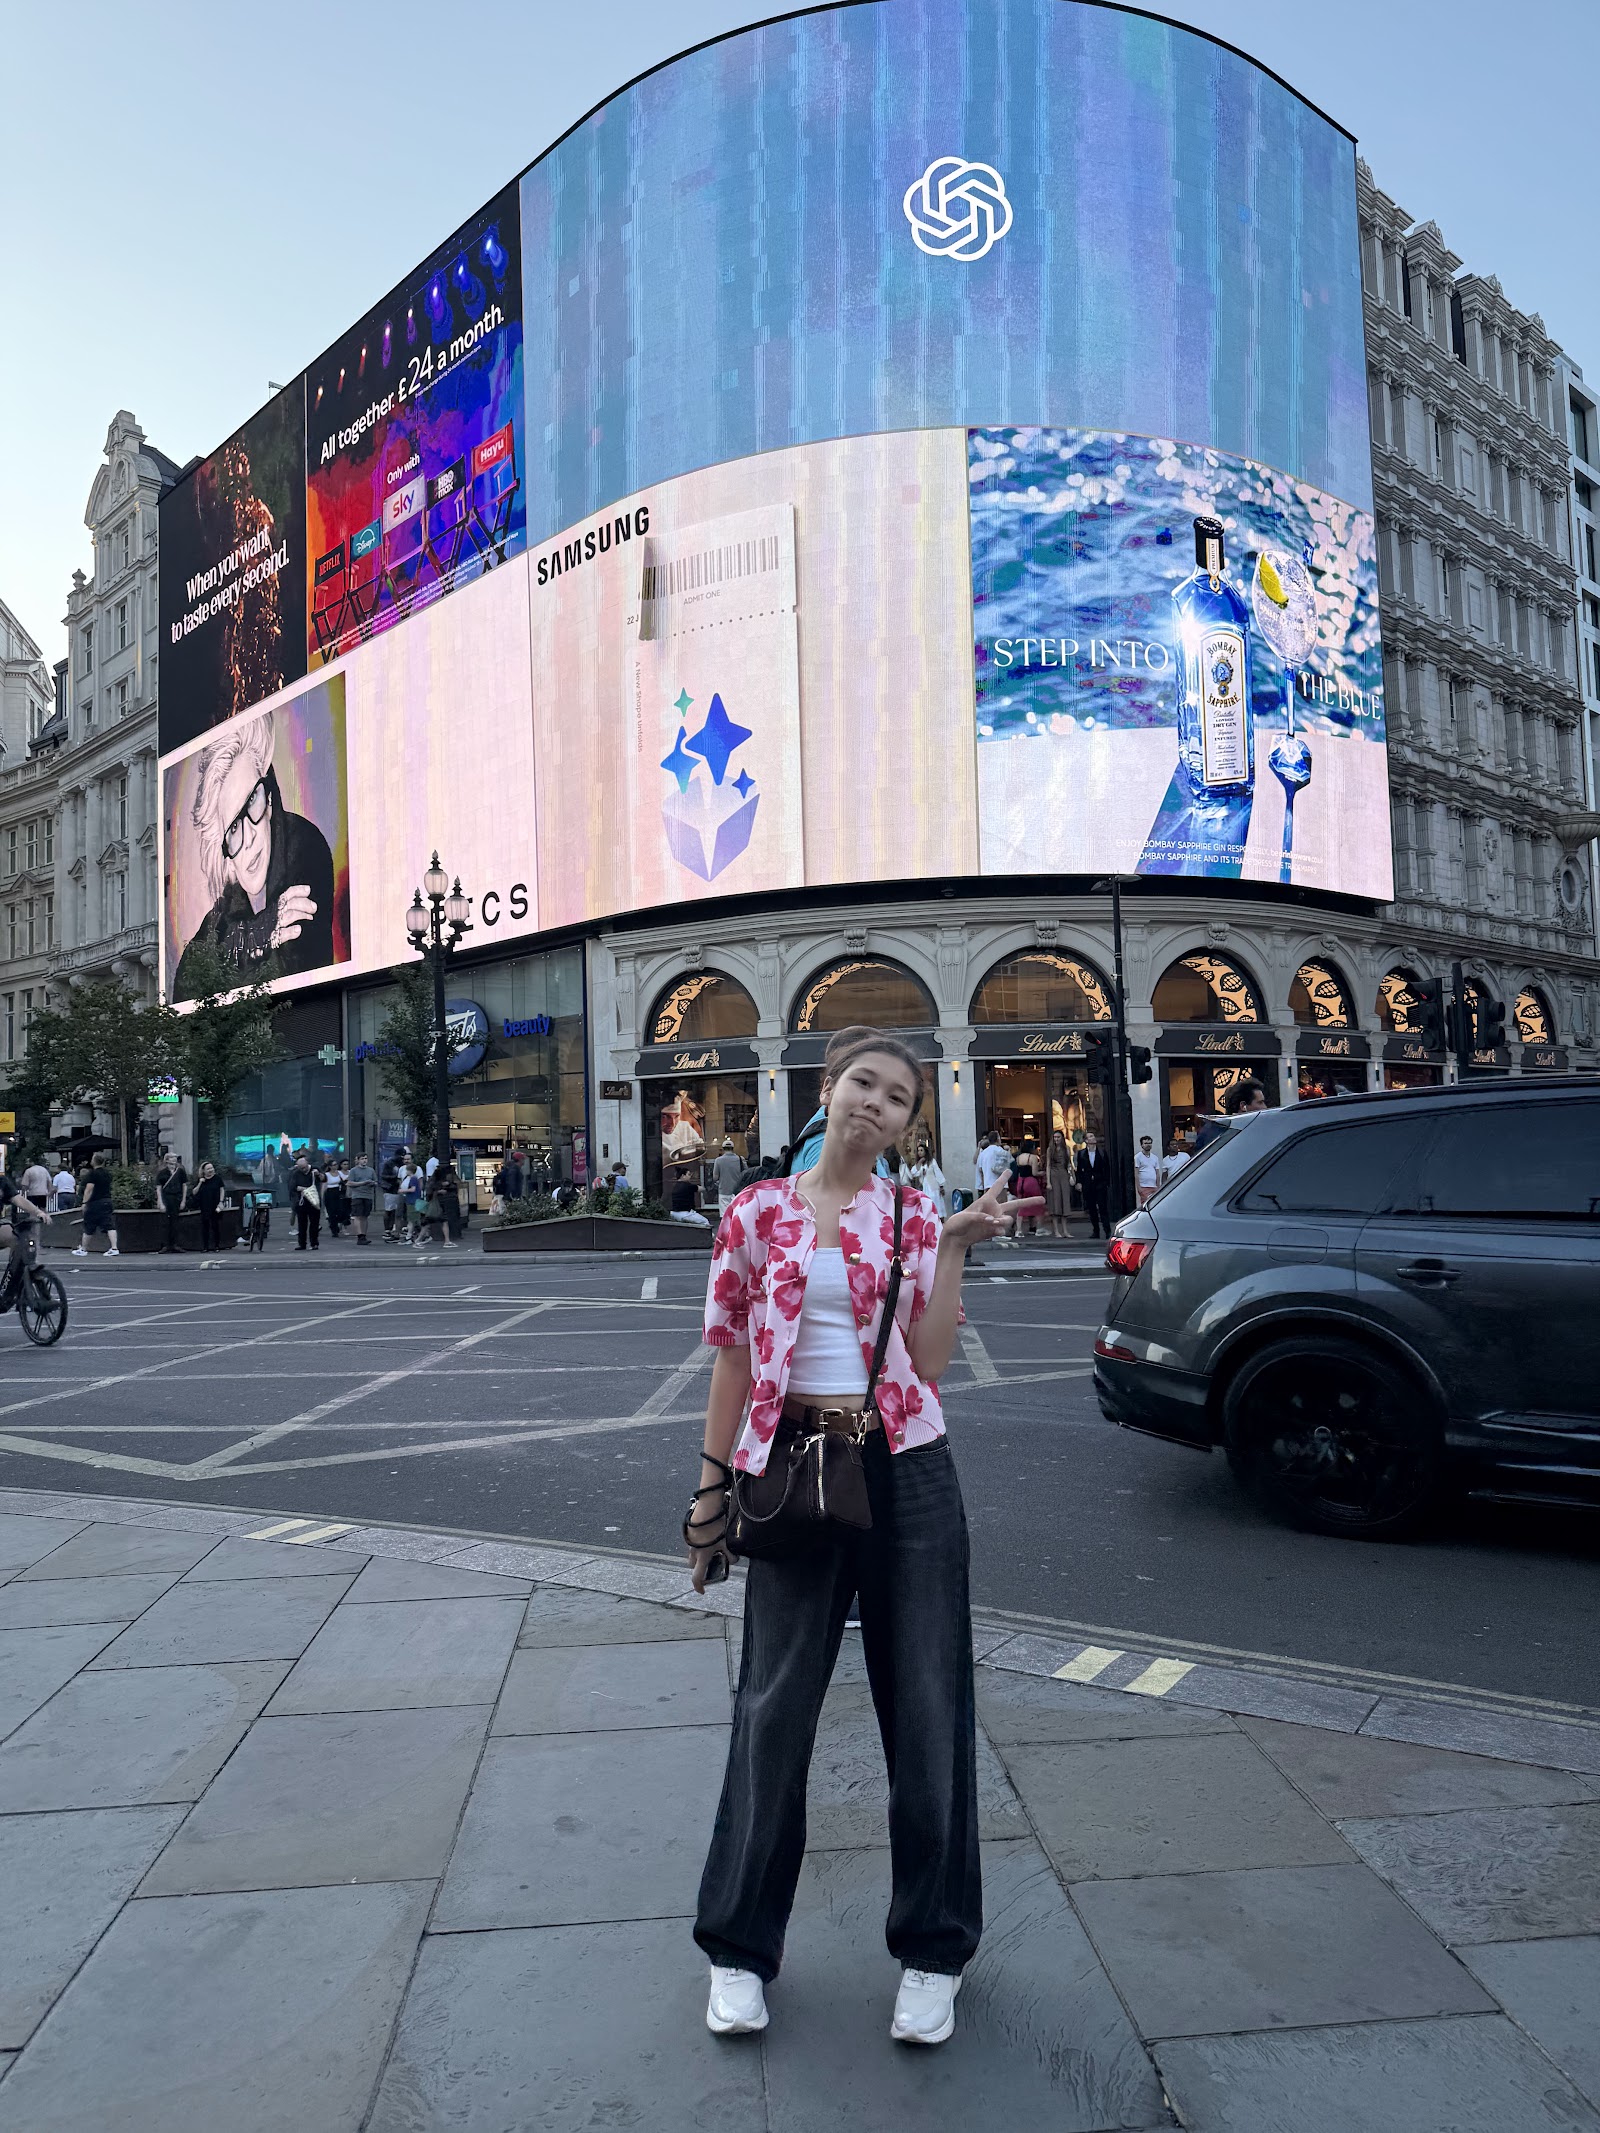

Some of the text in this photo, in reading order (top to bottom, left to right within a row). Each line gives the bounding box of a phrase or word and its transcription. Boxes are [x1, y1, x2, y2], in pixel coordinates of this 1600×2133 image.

[320, 432, 336, 465] All
[338, 391, 396, 446] together.
[398, 345, 434, 403] £24
[437, 350, 447, 371] a
[450, 303, 505, 362] month.
[480, 438, 505, 462] Hayu
[387, 453, 420, 485] Only with
[437, 470, 455, 489] HBO
[437, 481, 455, 499] max
[392, 489, 415, 519] sky
[537, 506, 650, 586] SAMSUNG
[186, 566, 217, 603] When
[240, 523, 270, 564] want
[318, 552, 342, 577] NETFLIX
[171, 539, 290, 644] to taste every second.
[683, 589, 721, 605] ADMIT ONE
[627, 615, 635, 625] 22
[1206, 641, 1237, 656] BOMBAY
[993, 638, 1381, 720] STEP INTO THE BLUE
[1206, 692, 1241, 708] SAPPHIRE
[1116, 840, 1142, 848] ENJOY
[1143, 840, 1176, 849] BOMBAY
[1177, 841, 1212, 851] SAPPHIRE
[1213, 843, 1226, 852] GIN
[1134, 852, 1166, 861] BOMBAY
[1167, 852, 1202, 862] SAPPHIRE
[1203, 855, 1219, 863] AND
[1220, 855, 1230, 864] ITS
[1231, 856, 1252, 867] TRADE
[1253, 859, 1272, 868] DRESS
[503, 1013, 552, 1038] beauty
[1018, 1033, 1069, 1052] Lindt
[1194, 1033, 1235, 1051] Lindt
[1319, 1037, 1344, 1055] Lindt
[669, 1053, 710, 1070] Lindt
[487, 1144, 503, 1153] DIOR
